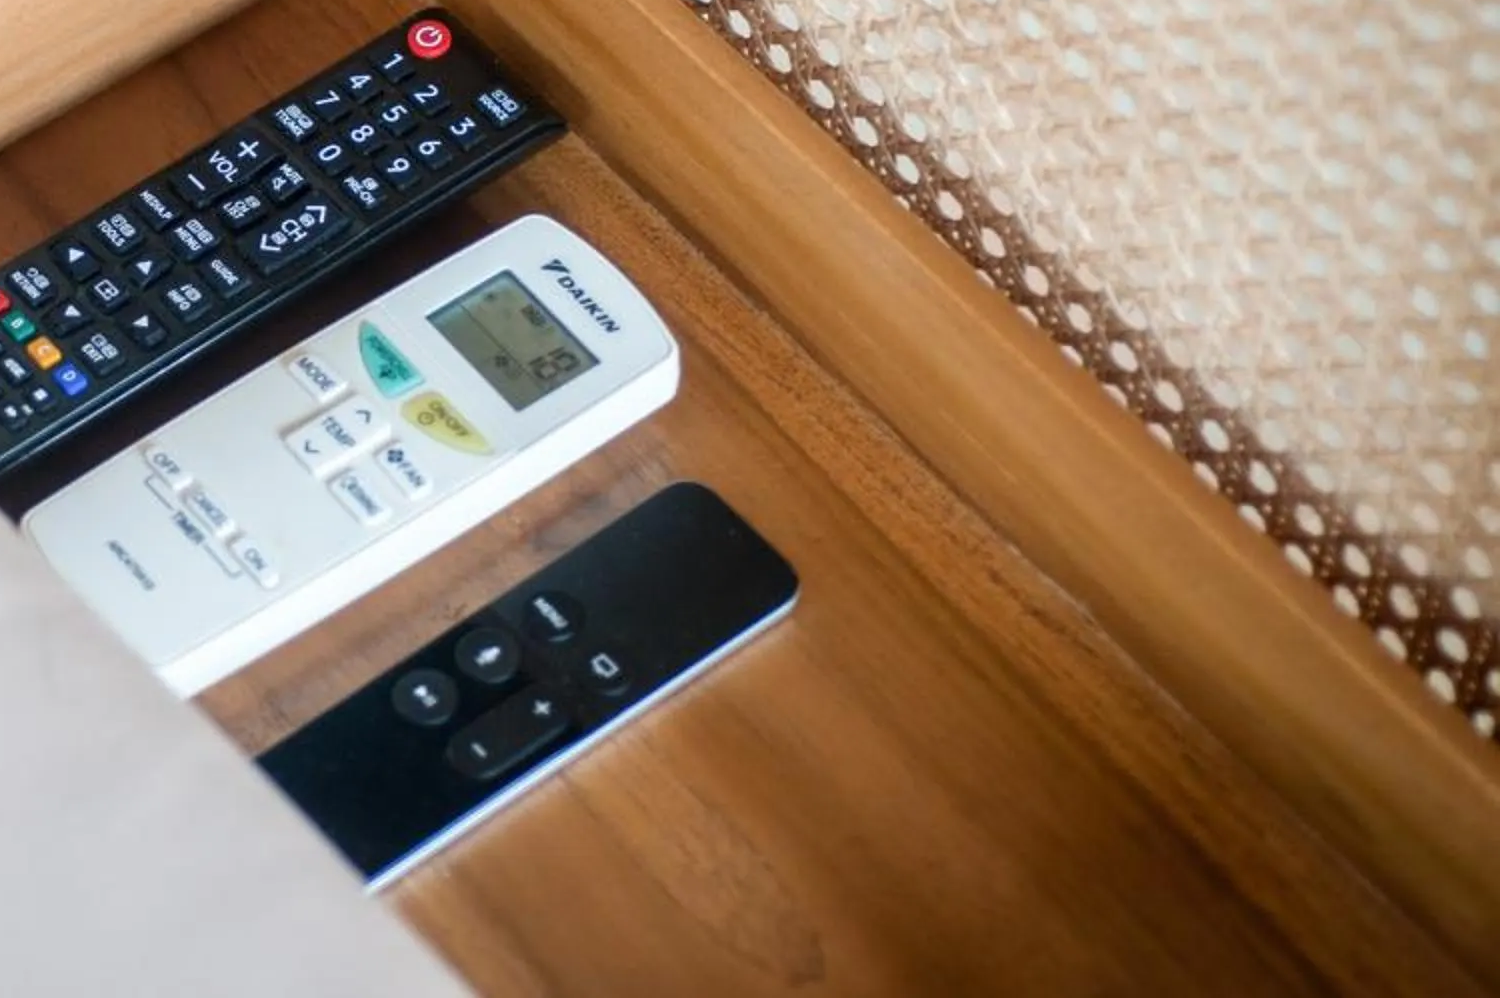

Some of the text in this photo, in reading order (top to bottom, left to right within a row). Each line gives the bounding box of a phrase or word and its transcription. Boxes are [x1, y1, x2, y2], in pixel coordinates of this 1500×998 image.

[384, 53, 476, 135] 1 2 3
[350, 73, 442, 155] 4 5 6
[315, 90, 409, 175] 7 8 9
[318, 144, 341, 162] 0
[208, 150, 240, 183] VOL
[279, 163, 302, 183] MUTE
[97, 220, 126, 246] TOOLS
[174, 226, 201, 250] MENU
[281, 218, 308, 243] CH
[558, 270, 620, 334] DAIKIN
[39, 346, 52, 358] C
[62, 370, 77, 382] D
[299, 357, 336, 392] MODE
[320, 416, 356, 448] TEMP
[152, 452, 180, 476] OFF
[399, 461, 426, 488] FAN
[172, 510, 206, 546] TIMER
[243, 547, 267, 572] ON
